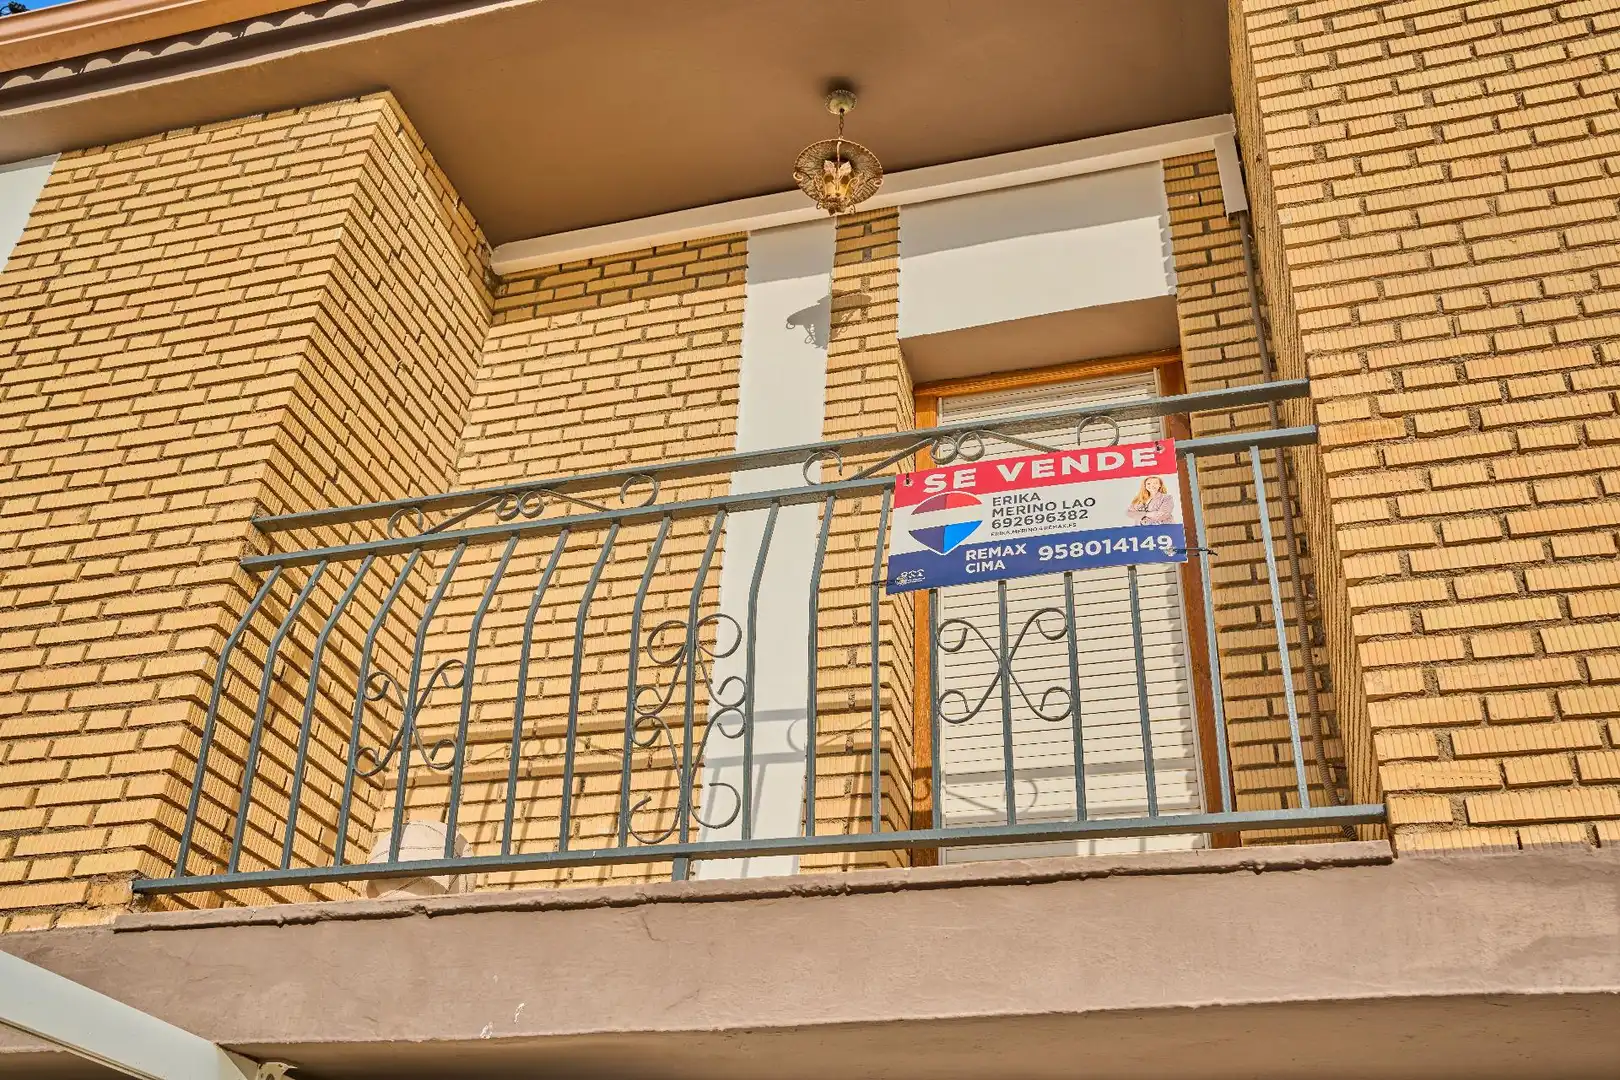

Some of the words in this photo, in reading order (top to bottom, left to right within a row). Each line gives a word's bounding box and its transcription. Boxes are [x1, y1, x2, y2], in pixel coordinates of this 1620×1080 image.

[922, 467, 977, 494] SE
[997, 448, 1158, 483] VENDE
[992, 492, 1041, 507] ERIKA
[992, 501, 1057, 518] MERINO
[1062, 497, 1096, 510] LAO
[991, 509, 1089, 530] 692696382
[965, 543, 1027, 562] REMAX
[1038, 534, 1173, 562] 958014149
[965, 559, 1006, 575] CIMA
